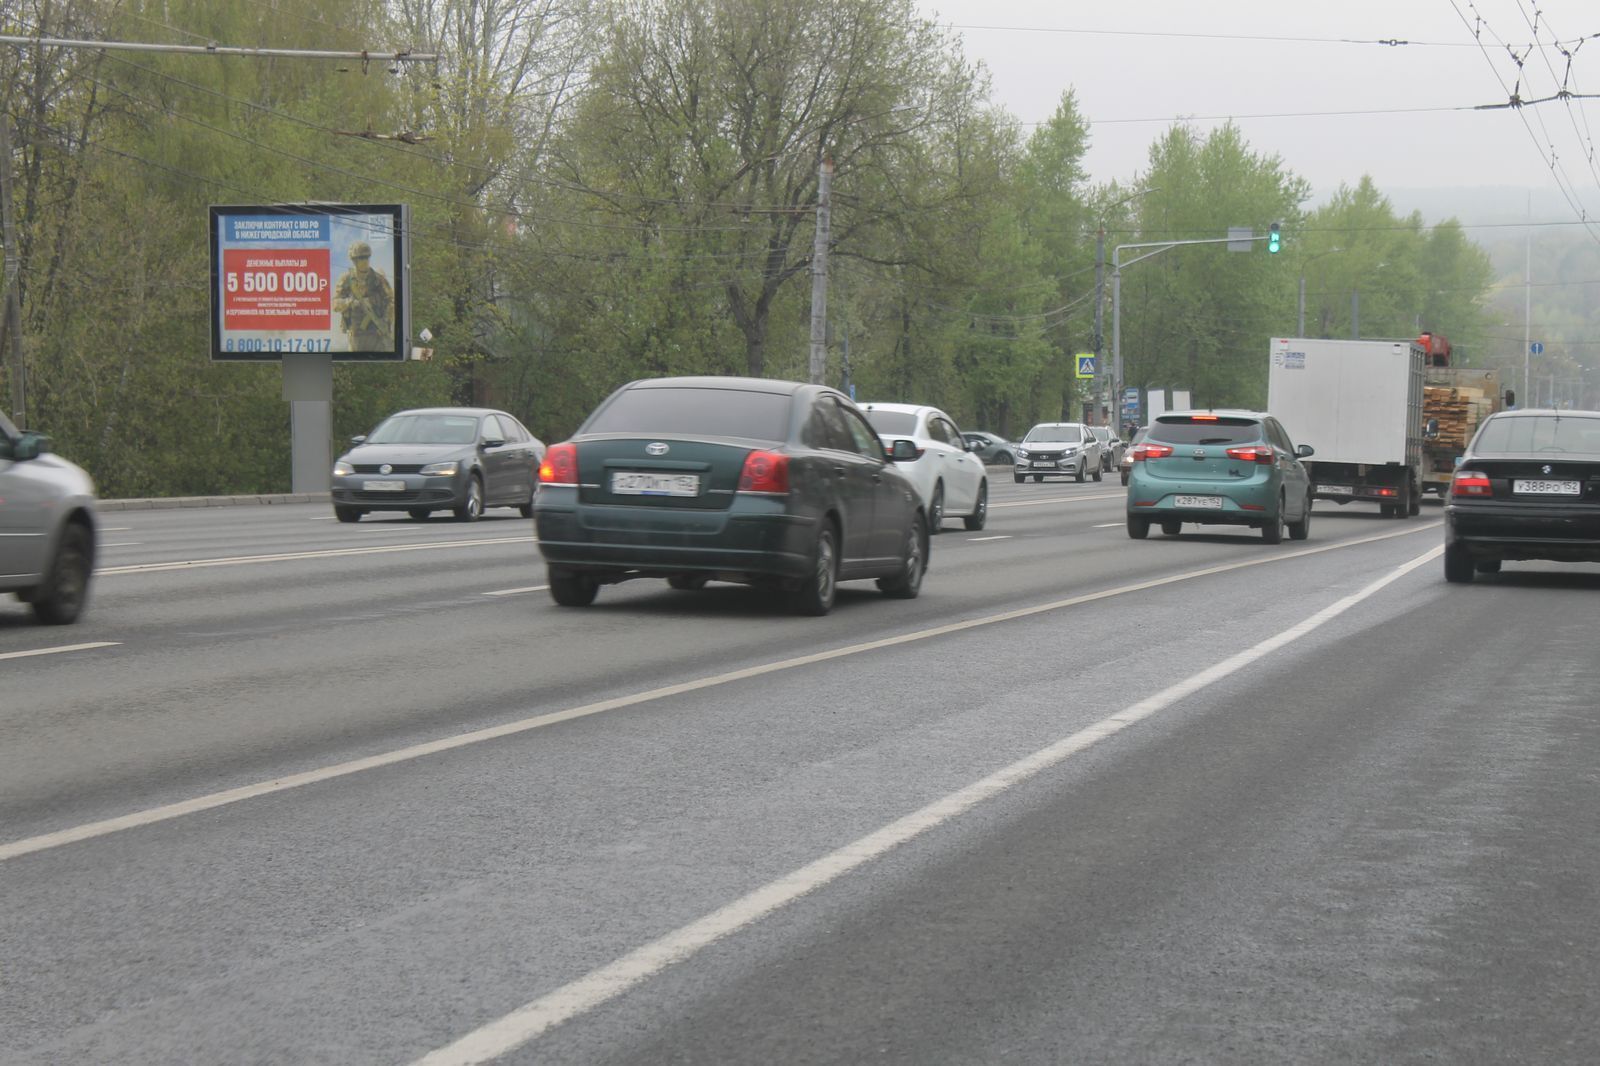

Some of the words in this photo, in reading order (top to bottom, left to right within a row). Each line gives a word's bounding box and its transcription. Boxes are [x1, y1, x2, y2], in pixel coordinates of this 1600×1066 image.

[234, 221, 263, 230] ЗАКЛЮЧИ
[263, 221, 293, 230] КОНТРАКТ
[294, 221, 299, 229] С
[300, 221, 309, 229] МО
[309, 221, 319, 229] РФ
[235, 230, 240, 239] В
[241, 229, 291, 240] НИЖЕГОРОДСКОЙ
[292, 230, 320, 239] ОБЛАСТИ
[246, 259, 273, 268] ДЕНЕЖНЫЕ
[274, 259, 299, 267] ВЫПЛАТЫ
[299, 259, 307, 268] ДО
[227, 272, 238, 292] 5
[243, 272, 278, 292] 500
[226, 338, 234, 352] 8
